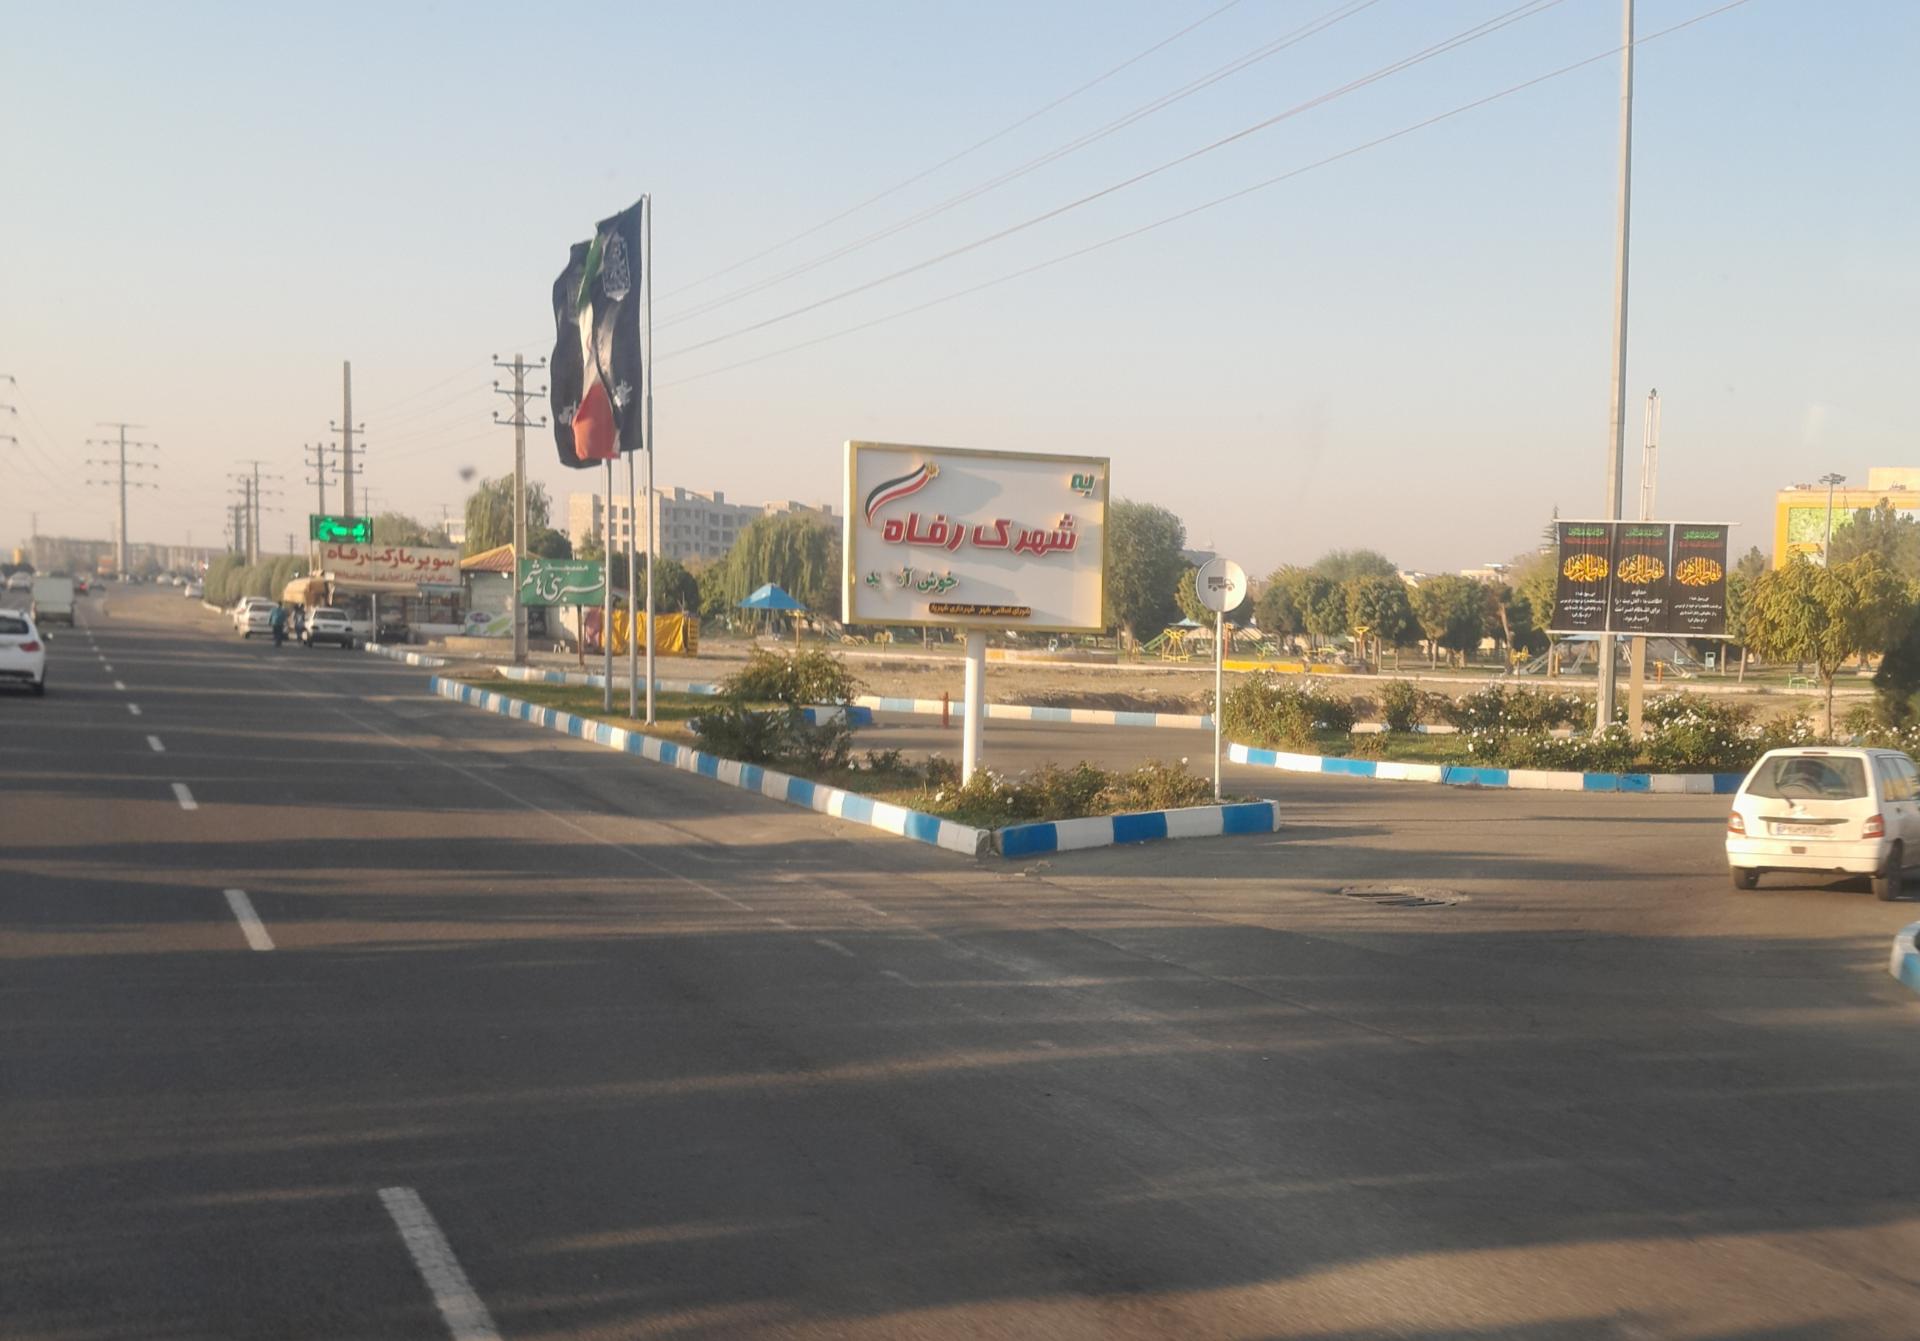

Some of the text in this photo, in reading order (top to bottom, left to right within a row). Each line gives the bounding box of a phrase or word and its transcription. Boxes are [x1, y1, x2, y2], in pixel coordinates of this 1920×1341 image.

[1071, 472, 1096, 496] به
[881, 512, 1079, 557] شهرک رفاه
[327, 544, 366, 566] رفاه
[522, 560, 543, 596] هاشم
[545, 563, 589, 575] مسجد
[865, 567, 960, 596] خوش آمید
